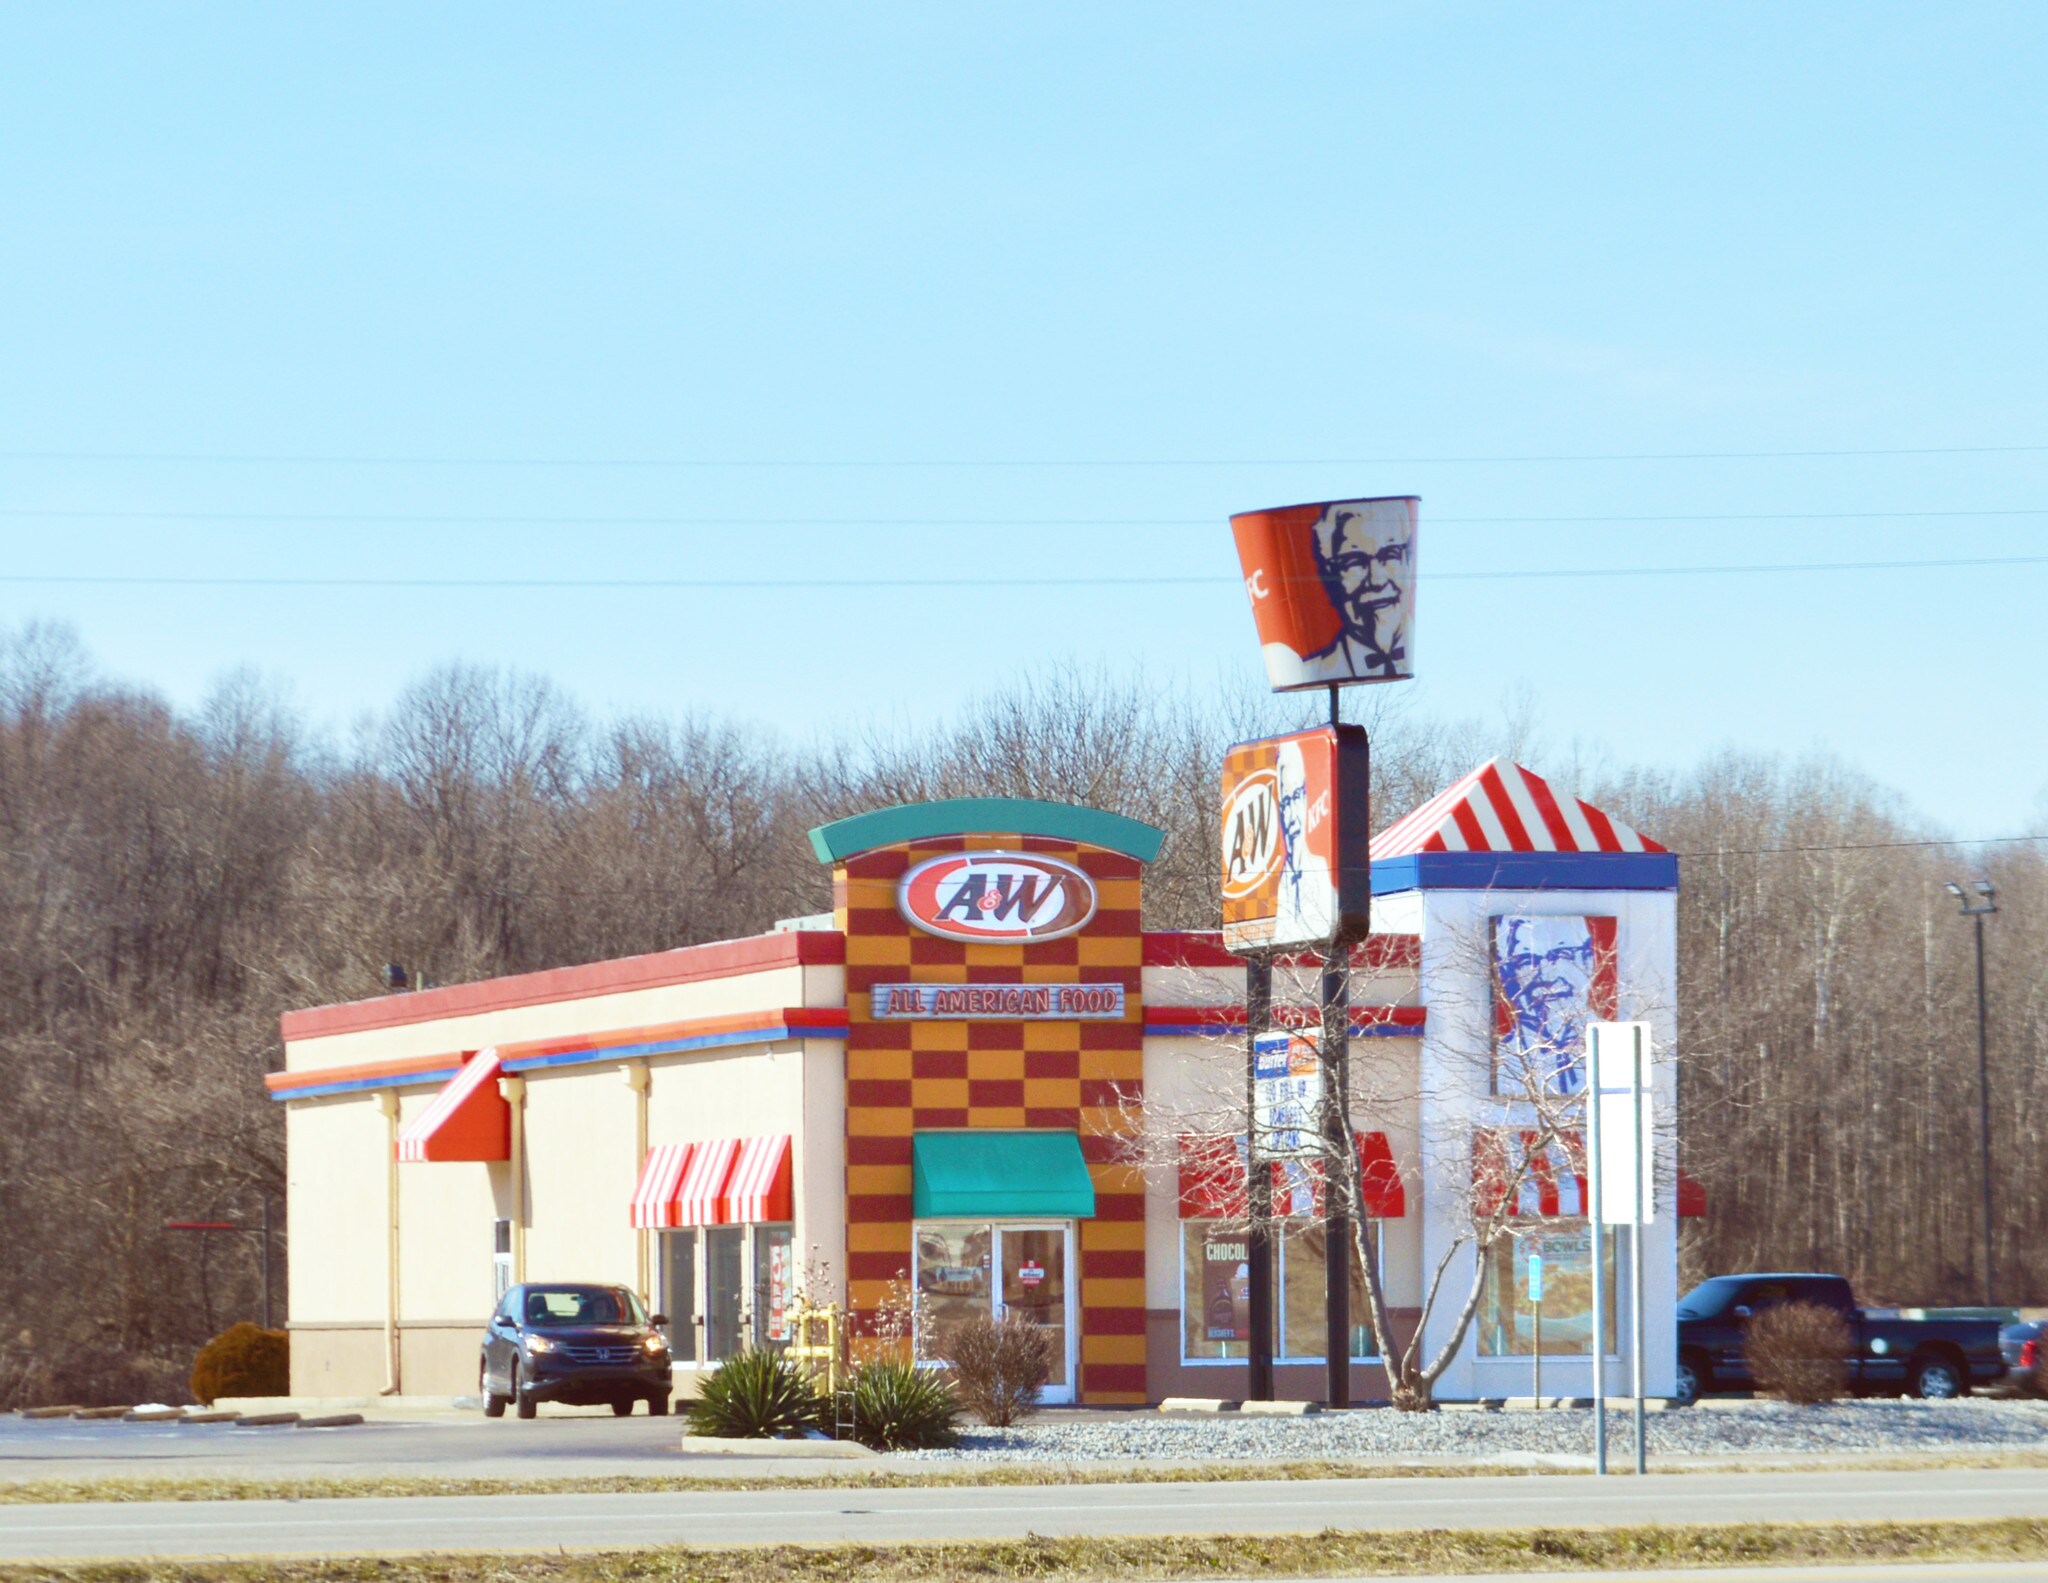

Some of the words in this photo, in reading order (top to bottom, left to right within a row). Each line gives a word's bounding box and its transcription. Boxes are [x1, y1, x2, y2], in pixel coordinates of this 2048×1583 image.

[1225, 780, 1275, 885] A&W
[1307, 789, 1329, 833] KFC
[933, 873, 1066, 922] A&W
[886, 988, 926, 1014] ALL
[933, 988, 1049, 1014] AMERICAN
[1058, 988, 1117, 1013] FOOD
[1543, 1240, 1592, 1252] BOWLS
